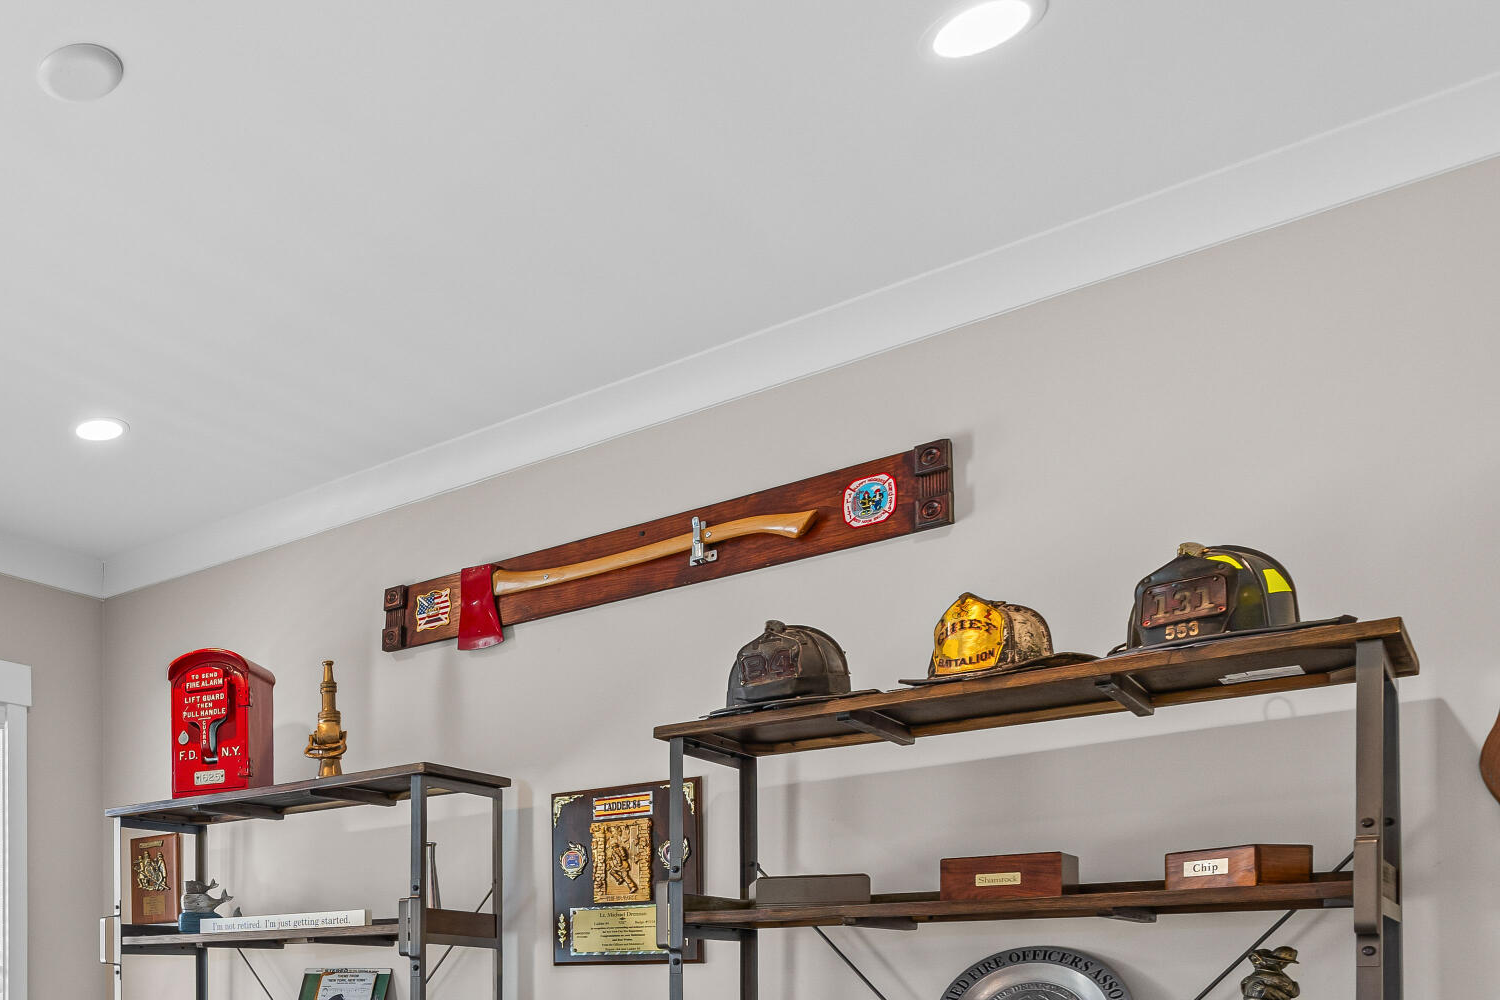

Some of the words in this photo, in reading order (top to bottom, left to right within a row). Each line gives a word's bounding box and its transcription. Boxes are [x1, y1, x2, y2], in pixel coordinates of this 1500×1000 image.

[1151, 587, 1215, 619] 131
[1165, 621, 1199, 640] 553
[186, 681, 200, 690] FIRE
[200, 678, 223, 687] ALARM
[184, 695, 200, 704] LIFT
[202, 693, 225, 702] GUARD
[200, 707, 226, 717] HANDLE
[179, 750, 198, 761] F.D.
[221, 746, 241, 757] N.Y.
[1193, 863, 1219, 874] Chip
[978, 875, 1018, 884] Shamrock
[212, 922, 224, 931] I'm
[225, 922, 235, 930] not
[237, 921, 262, 930] retired.
[265, 919, 276, 929] I'm
[277, 918, 292, 930] just
[293, 916, 320, 929] getting
[321, 914, 350, 926] started.
[968, 956, 1006, 981] FIRE
[1008, 950, 1093, 972] OFFICERS
